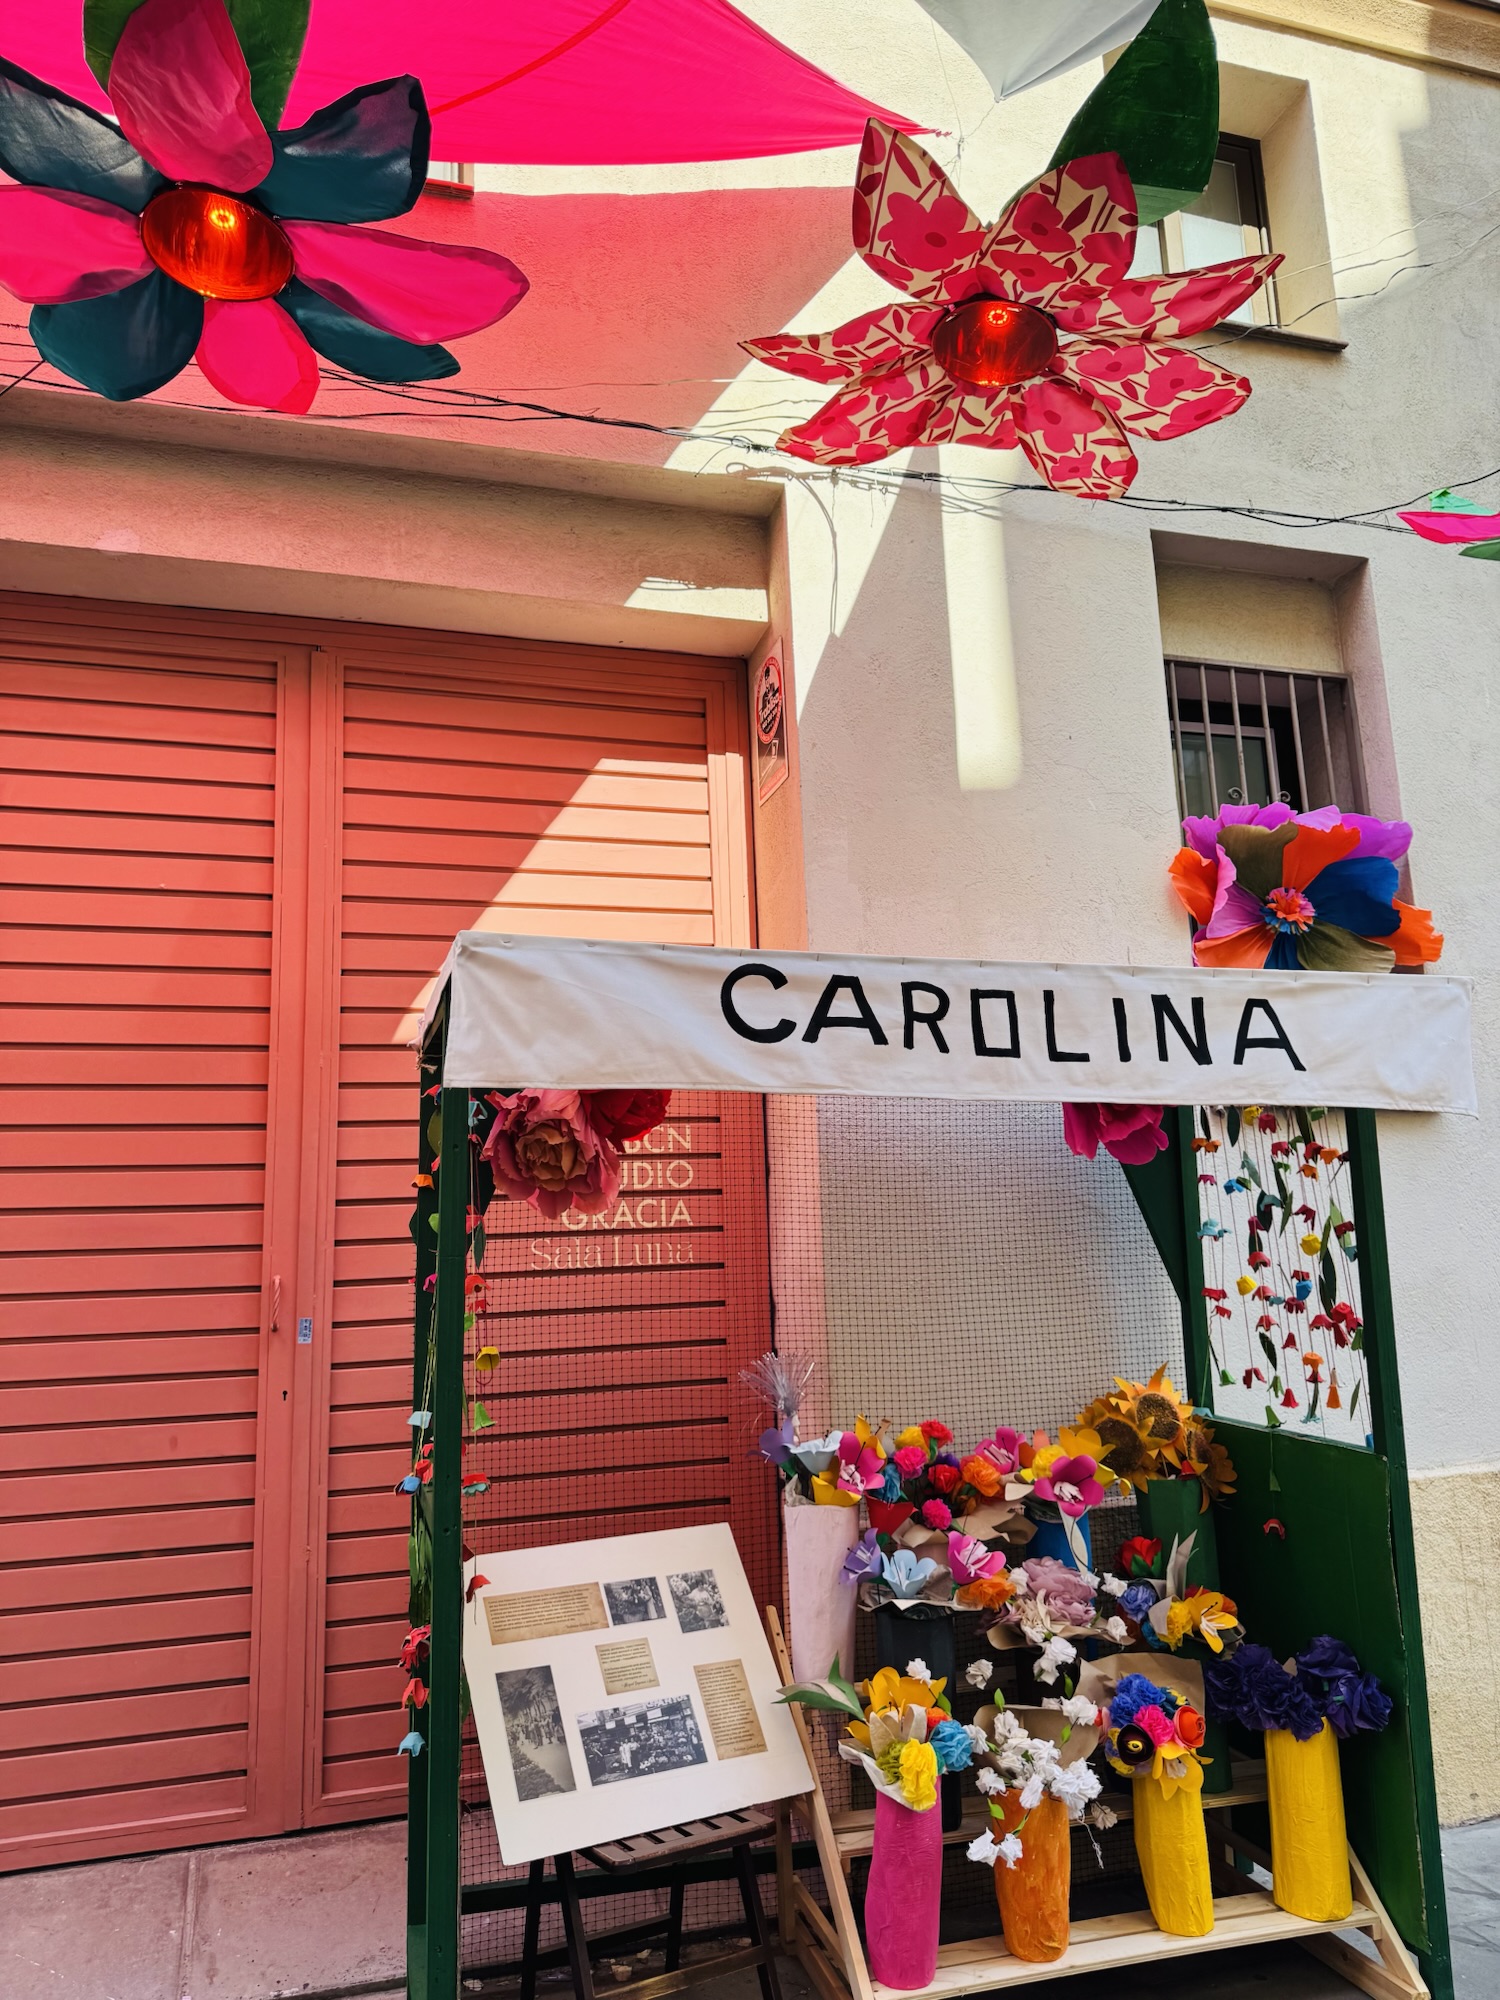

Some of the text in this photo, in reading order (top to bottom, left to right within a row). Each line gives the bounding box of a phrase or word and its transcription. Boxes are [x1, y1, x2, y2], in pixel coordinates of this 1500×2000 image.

[719, 962, 1307, 1072] CAROLINA
[561, 1199, 694, 1230] GRACIA
[530, 1236, 694, 1271] Sala Luna
